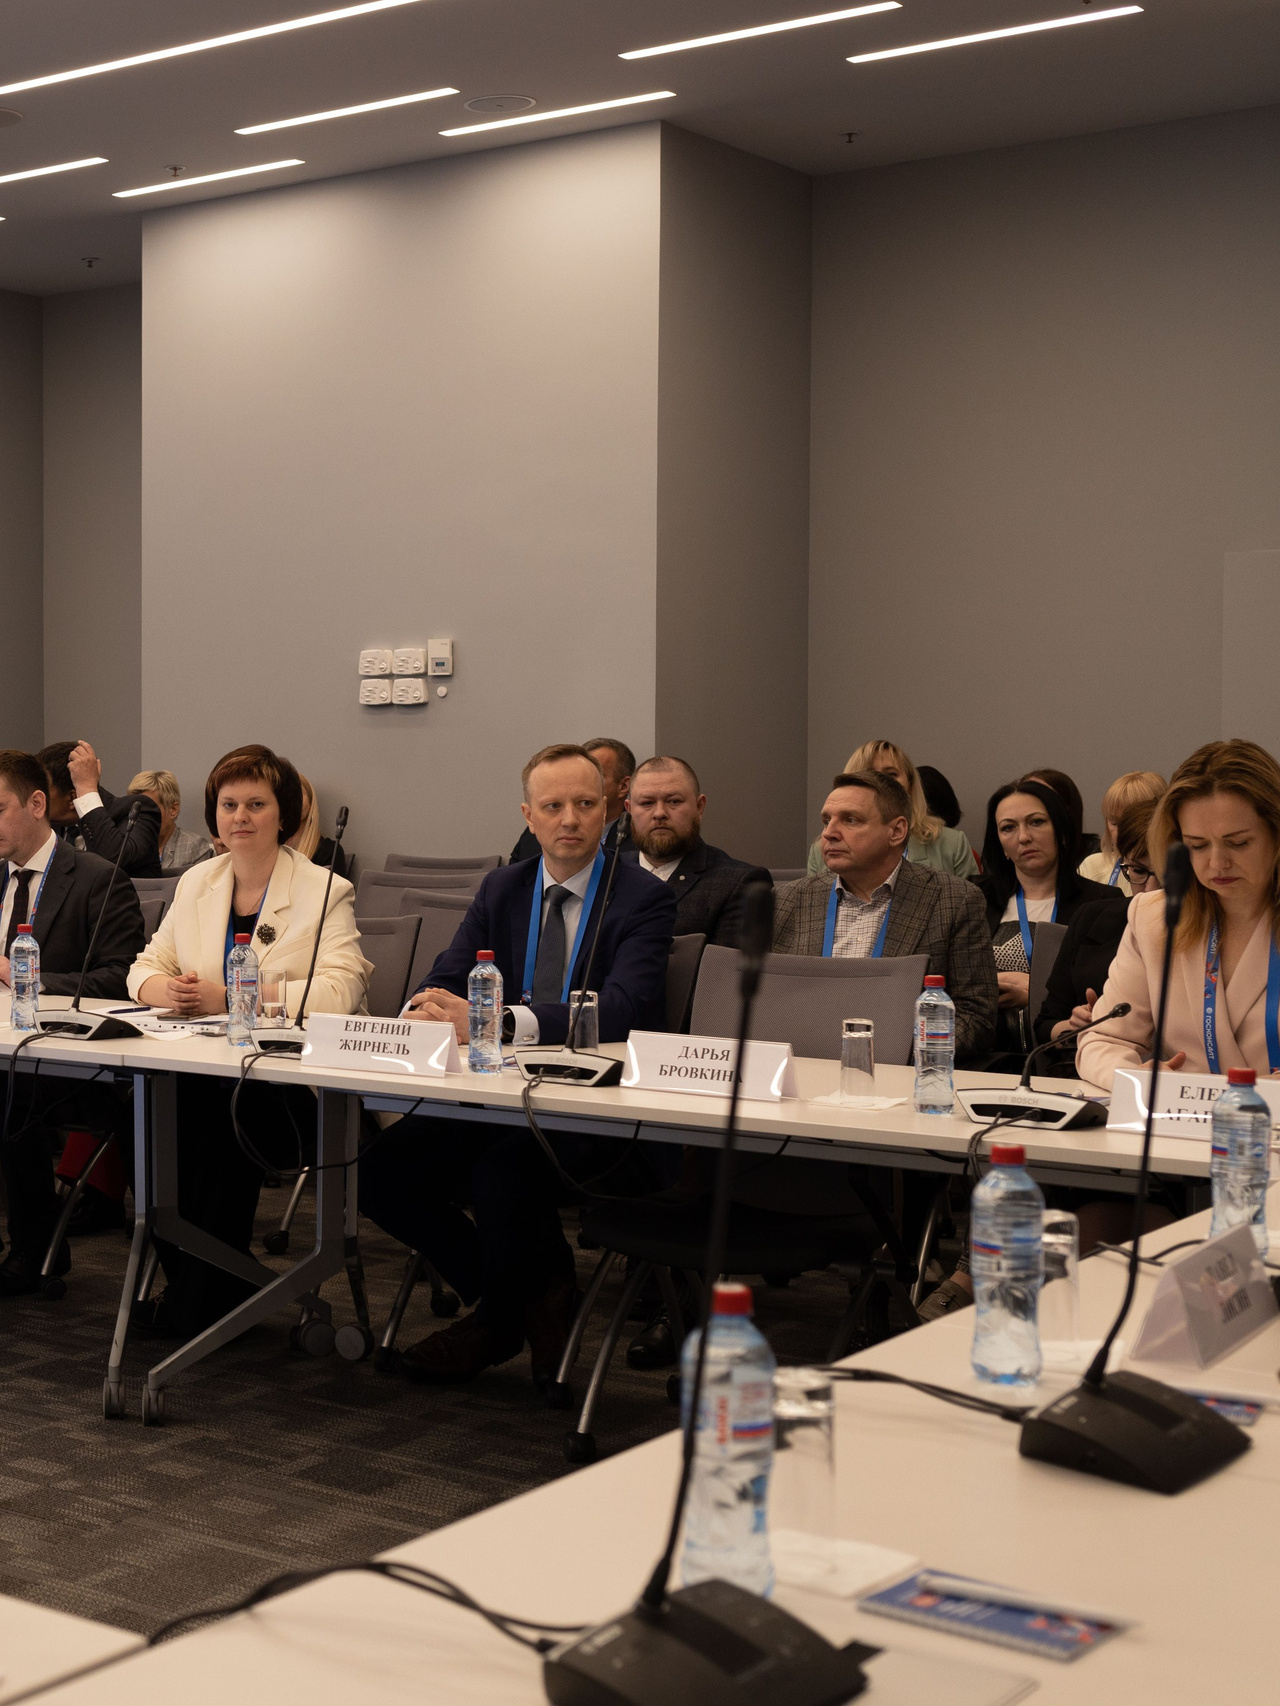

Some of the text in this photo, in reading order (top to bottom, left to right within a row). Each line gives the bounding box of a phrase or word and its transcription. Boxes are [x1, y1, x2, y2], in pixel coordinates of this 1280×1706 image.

[344, 1020, 412, 1037] ЕВГЕНИЙ
[1206, 1015, 1215, 1060] ГОСКОНСАЛТ
[339, 1038, 410, 1056] ЖИРНЕЛЬ
[678, 1045, 731, 1062] ДАРЬЯ
[1011, 1097, 1039, 1105] BOSCH
[1179, 1085, 1227, 1101] ЕЛЕ
